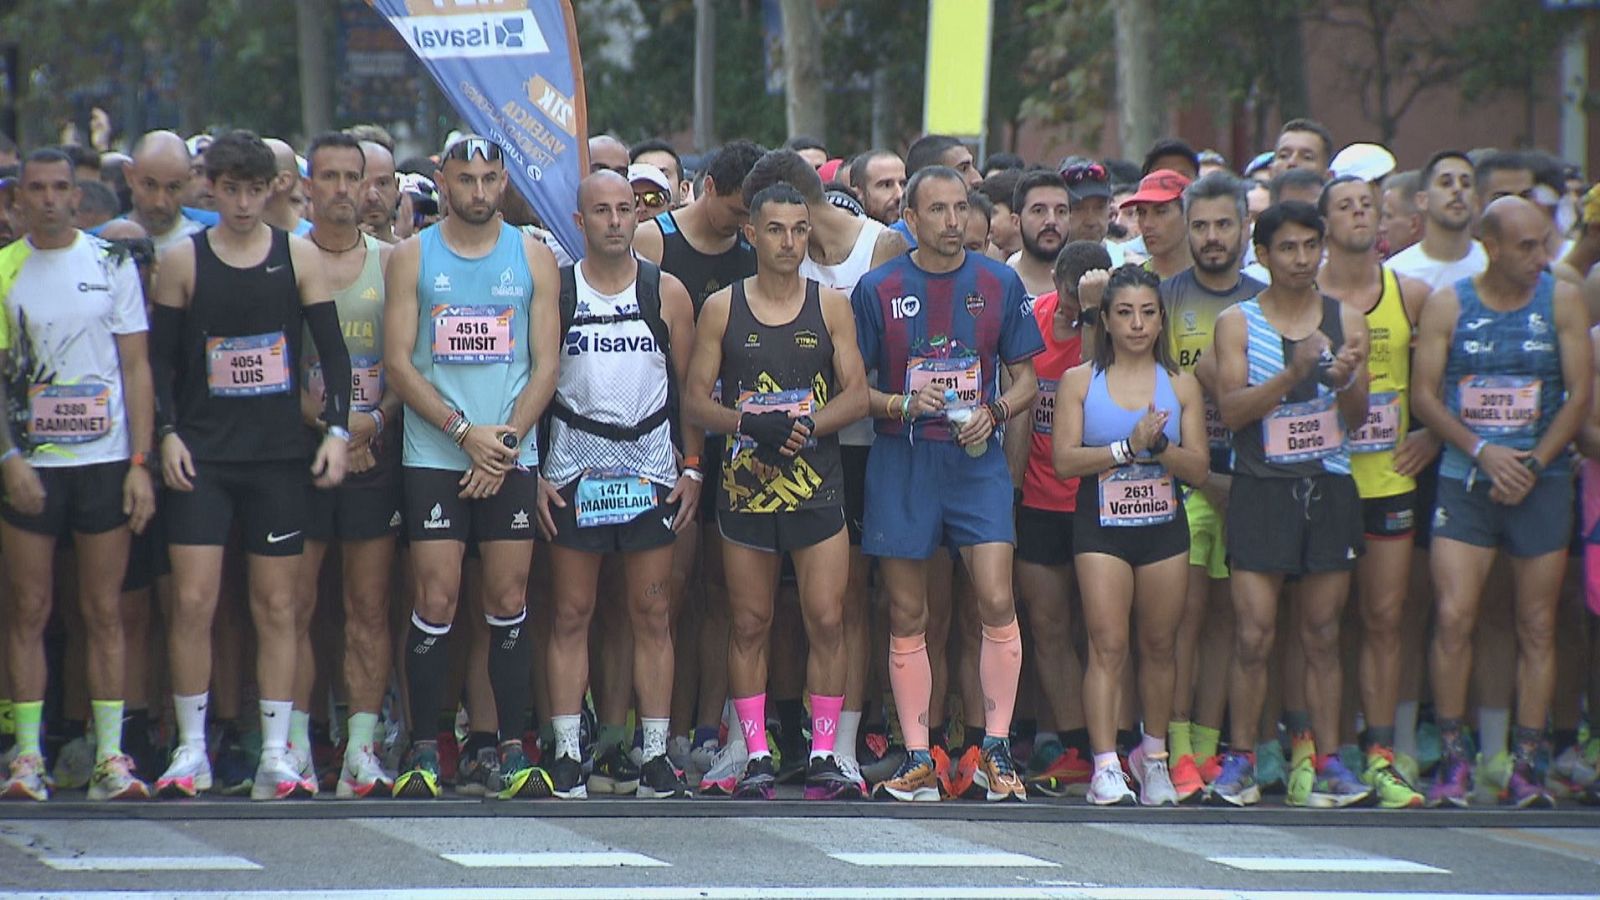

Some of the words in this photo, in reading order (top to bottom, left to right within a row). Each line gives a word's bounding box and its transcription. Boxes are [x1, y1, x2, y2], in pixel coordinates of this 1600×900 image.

[455, 322, 489, 335] 4516
[447, 336, 497, 352] TIMSIT
[230, 354, 263, 369] 4054
[1179, 349, 1202, 366] BA
[231, 369, 265, 384] LUIS
[1040, 396, 1055, 409] 44
[34, 417, 106, 432] RAMONET
[598, 482, 629, 497] 1471
[1124, 485, 1155, 498] 2631
[580, 495, 653, 514] MANUELAIA
[1110, 498, 1169, 515] Verónica
